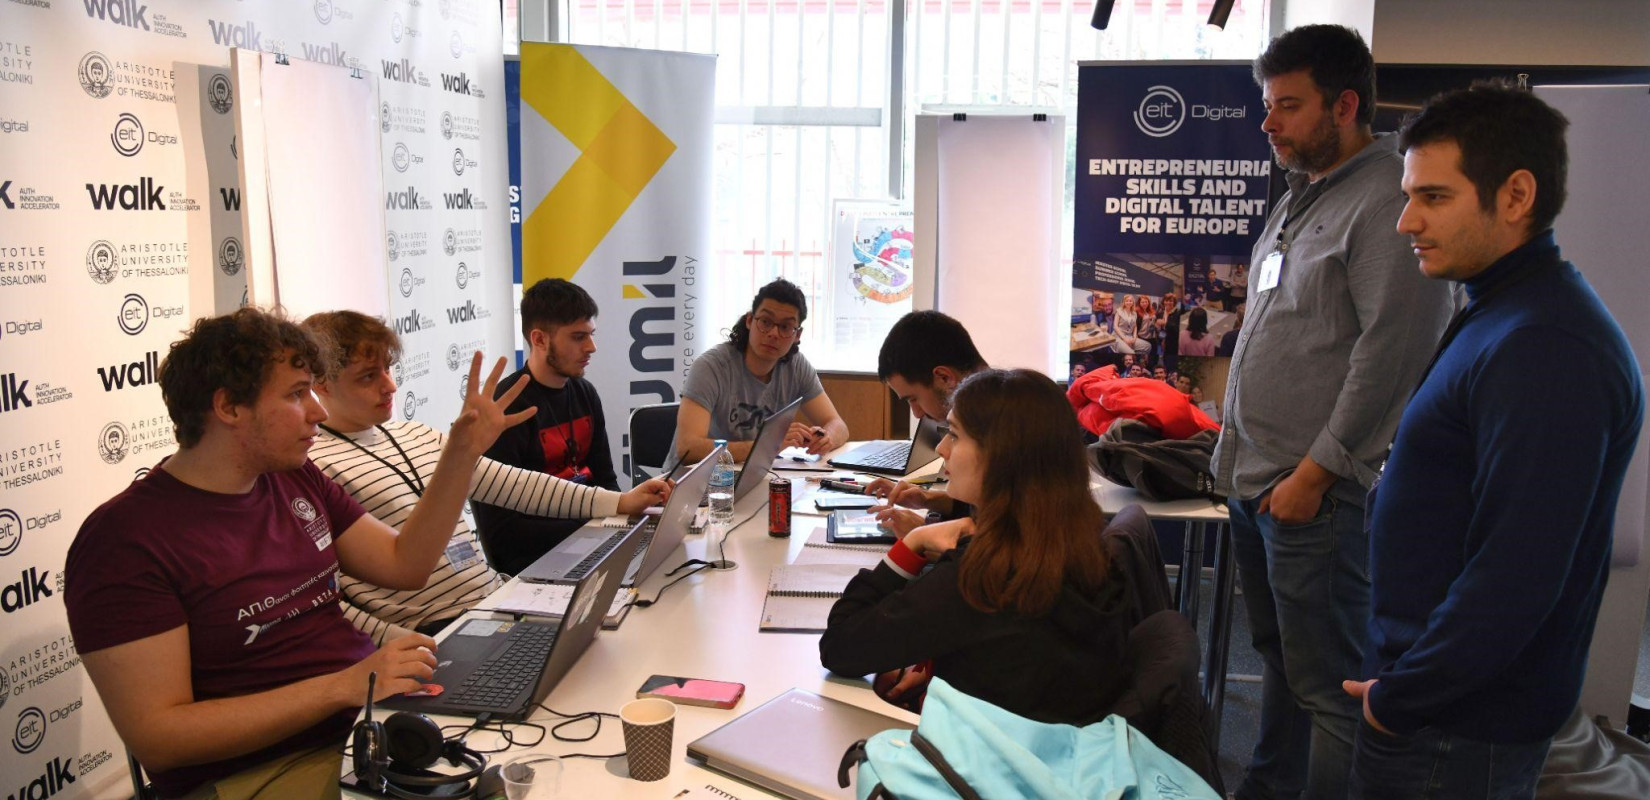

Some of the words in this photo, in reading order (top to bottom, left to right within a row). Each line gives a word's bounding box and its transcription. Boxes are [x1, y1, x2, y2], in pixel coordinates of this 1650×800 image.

[84, 0, 150, 31] walk
[208, 19, 262, 51] walk
[301, 42, 347, 67] walk
[116, 61, 175, 80] ARISTOTLE
[381, 59, 417, 84] walk
[117, 74, 175, 91] UNIVERSITY
[441, 72, 471, 95] walk
[117, 86, 128, 96] OF
[130, 88, 177, 104] THESSALONIKI
[1146, 102, 1173, 118] eit
[1191, 104, 1246, 121] Digital
[119, 127, 136, 141] eit
[148, 131, 178, 145] Digital
[85, 176, 166, 211] walk
[1126, 178, 1196, 195] SKILLS
[1200, 179, 1247, 196] AND
[386, 186, 419, 210] walk
[443, 188, 473, 209] walk
[1105, 197, 1184, 214] DIGITAL
[1189, 198, 1266, 216] TALENT
[1120, 216, 1161, 233] FOR
[1165, 217, 1250, 235] EUROPE
[121, 243, 188, 252] ARISTOTLE
[121, 254, 188, 266] UNIVERSITY
[122, 269, 133, 278] OF
[135, 266, 189, 278] THESSALONIKI
[681, 255, 698, 286] day
[124, 307, 142, 321] eit
[152, 304, 184, 319] Digital
[446, 299, 476, 324] walk
[683, 293, 698, 341] every
[6, 319, 43, 335] Digital
[393, 309, 421, 335] walk
[35, 383, 50, 391] AUTH
[36, 387, 67, 398] INNOVATION
[37, 392, 73, 405] ACCELERATOR
[132, 444, 143, 454] OF
[4, 466, 63, 490] THESSALONIKI
[26, 510, 62, 531] Digital
[312, 589, 333, 608] BETA
[13, 683, 25, 696] OF
[20, 719, 39, 739] eit
[49, 696, 83, 723] Digital
[78, 753, 91, 764] AUTH
[79, 750, 107, 770] INNOVATION
[80, 753, 113, 776] ACCELERATOR
